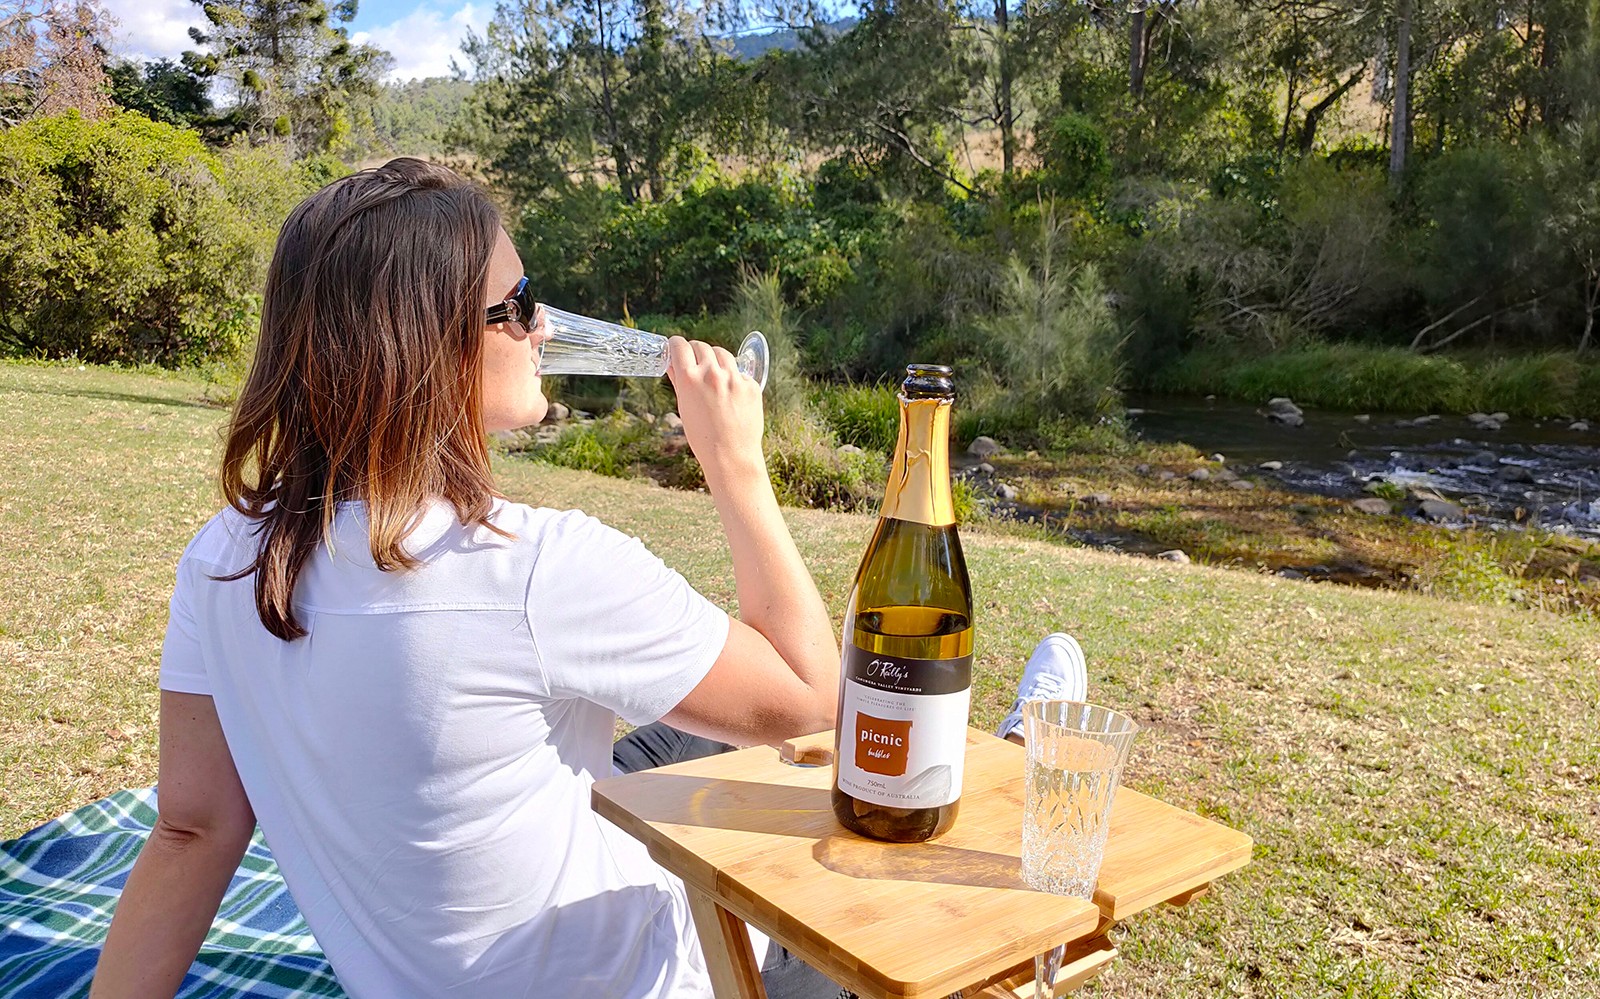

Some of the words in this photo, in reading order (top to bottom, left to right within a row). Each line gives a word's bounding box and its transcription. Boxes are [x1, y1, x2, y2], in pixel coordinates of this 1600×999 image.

[861, 729, 902, 747] picnic
[867, 747, 891, 759] bubbles
[853, 783, 876, 794] PRODUCT
[867, 780, 886, 789] 750mL
